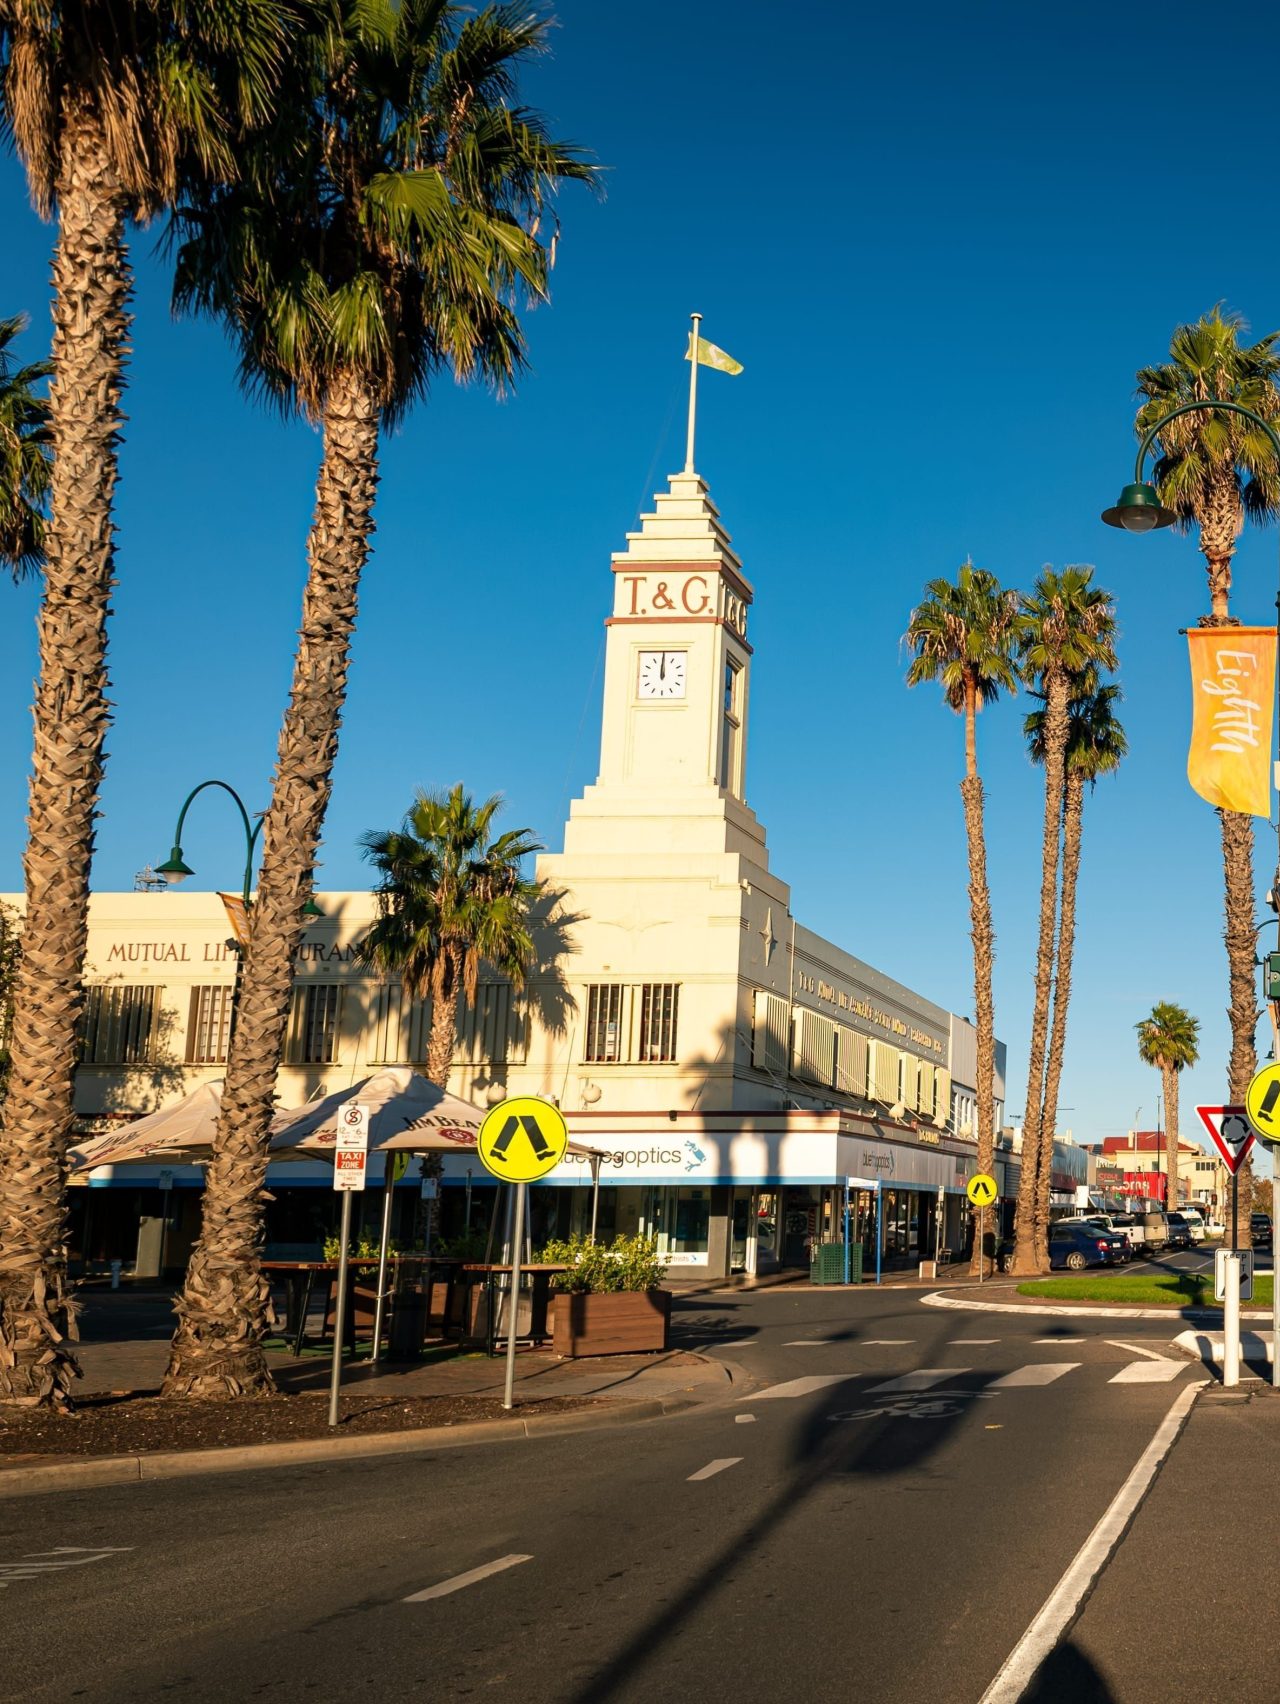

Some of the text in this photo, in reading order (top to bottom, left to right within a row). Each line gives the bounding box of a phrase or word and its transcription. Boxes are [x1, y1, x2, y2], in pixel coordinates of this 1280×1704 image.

[1200, 649, 1262, 754] Eighth
[106, 942, 192, 963] MUTUAL
[433, 1115, 482, 1129] BEA
[341, 1152, 361, 1160] TAXI
[340, 1161, 360, 1169] ZONE
